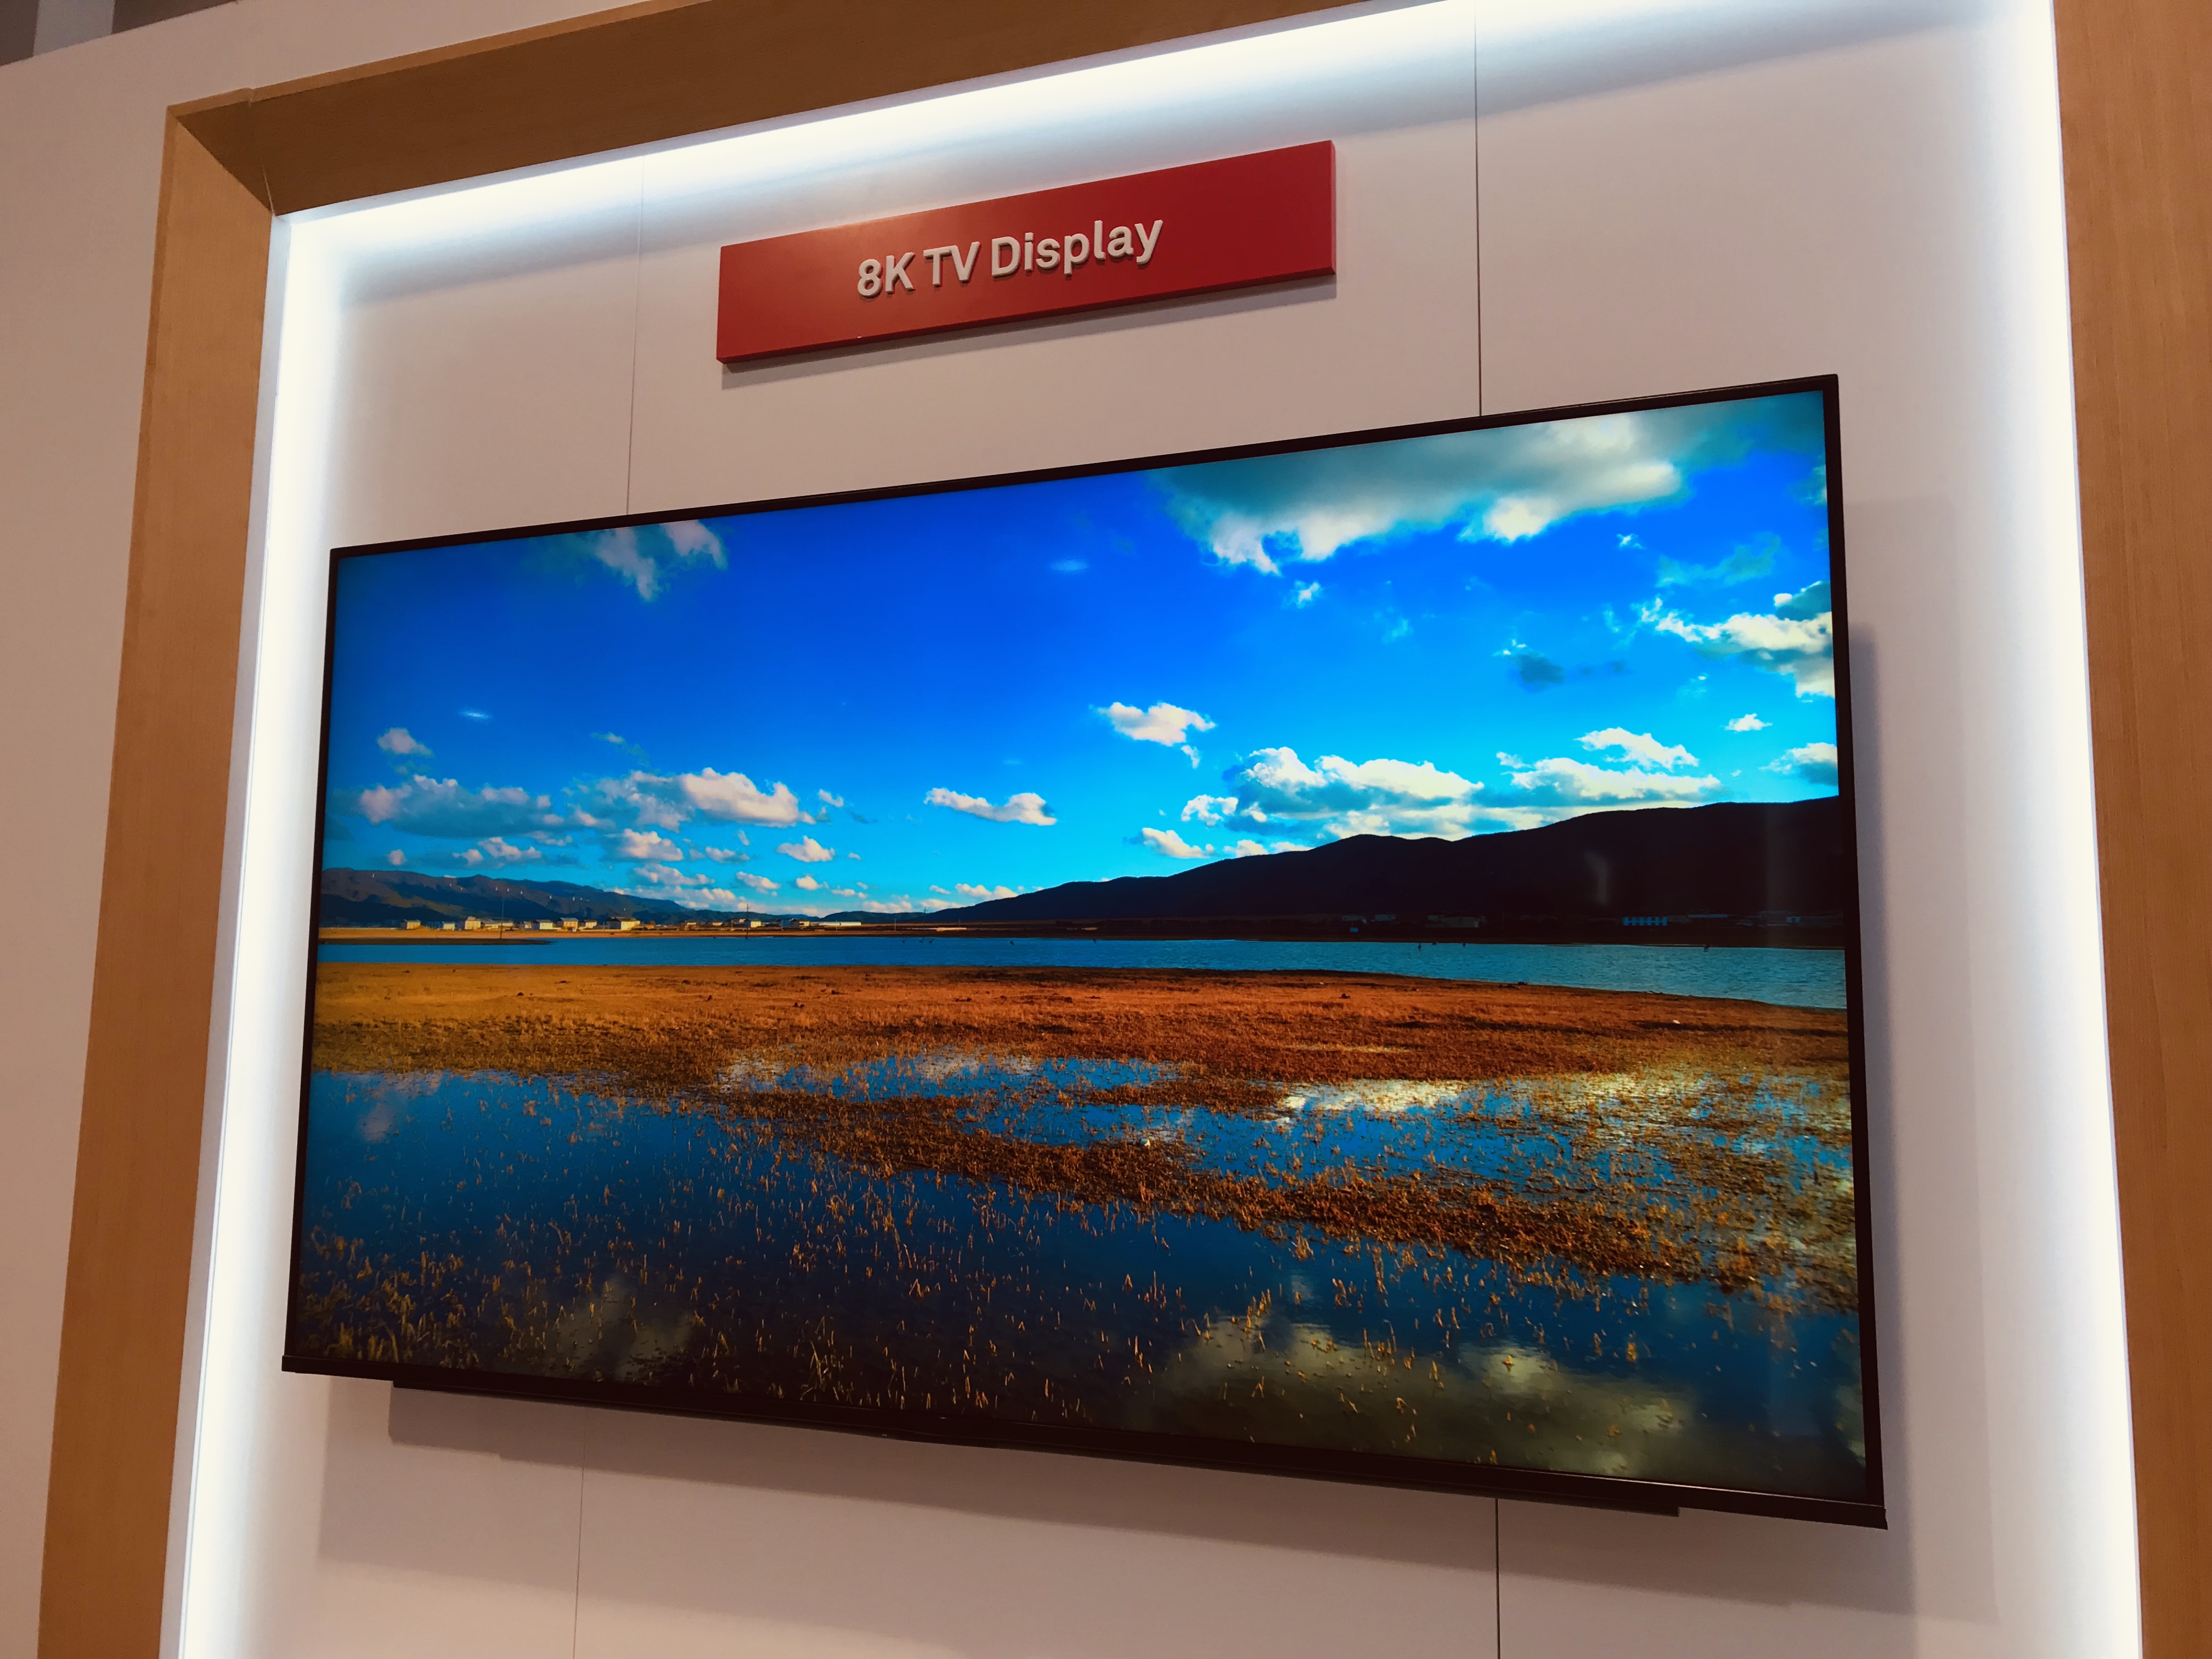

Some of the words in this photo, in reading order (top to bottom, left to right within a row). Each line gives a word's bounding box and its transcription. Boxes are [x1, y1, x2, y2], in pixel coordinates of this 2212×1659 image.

[857, 252, 915, 297] 8K
[923, 241, 980, 286] TV
[991, 219, 1163, 275] Display
